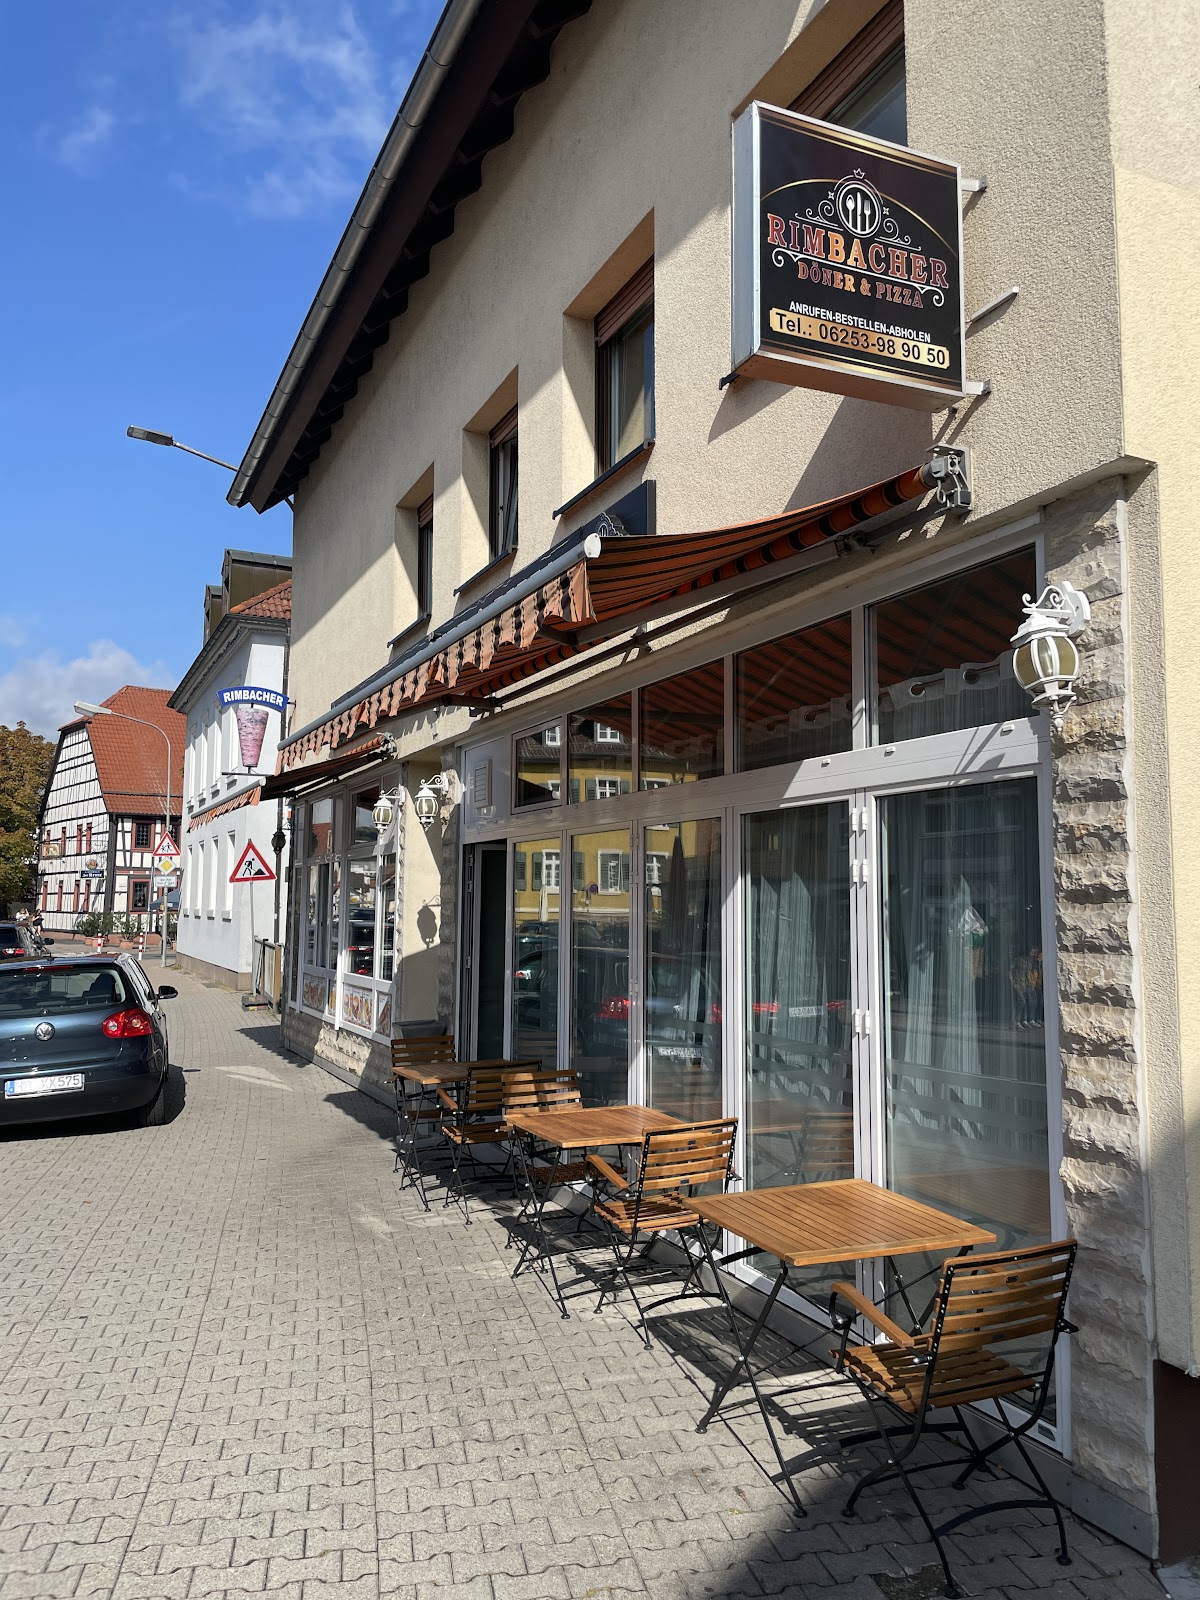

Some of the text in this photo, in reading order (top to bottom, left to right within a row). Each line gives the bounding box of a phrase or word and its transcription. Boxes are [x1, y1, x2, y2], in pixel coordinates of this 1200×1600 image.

[767, 213, 949, 289] RIMBACHER
[797, 261, 924, 308] DÖNER & PIZZA
[775, 312, 946, 366] Tel.: 06253-98 90 50
[789, 301, 931, 343] ANRUFEN-BESTELLEN-ABHOLEN
[223, 690, 284, 707] RIMBACHER
